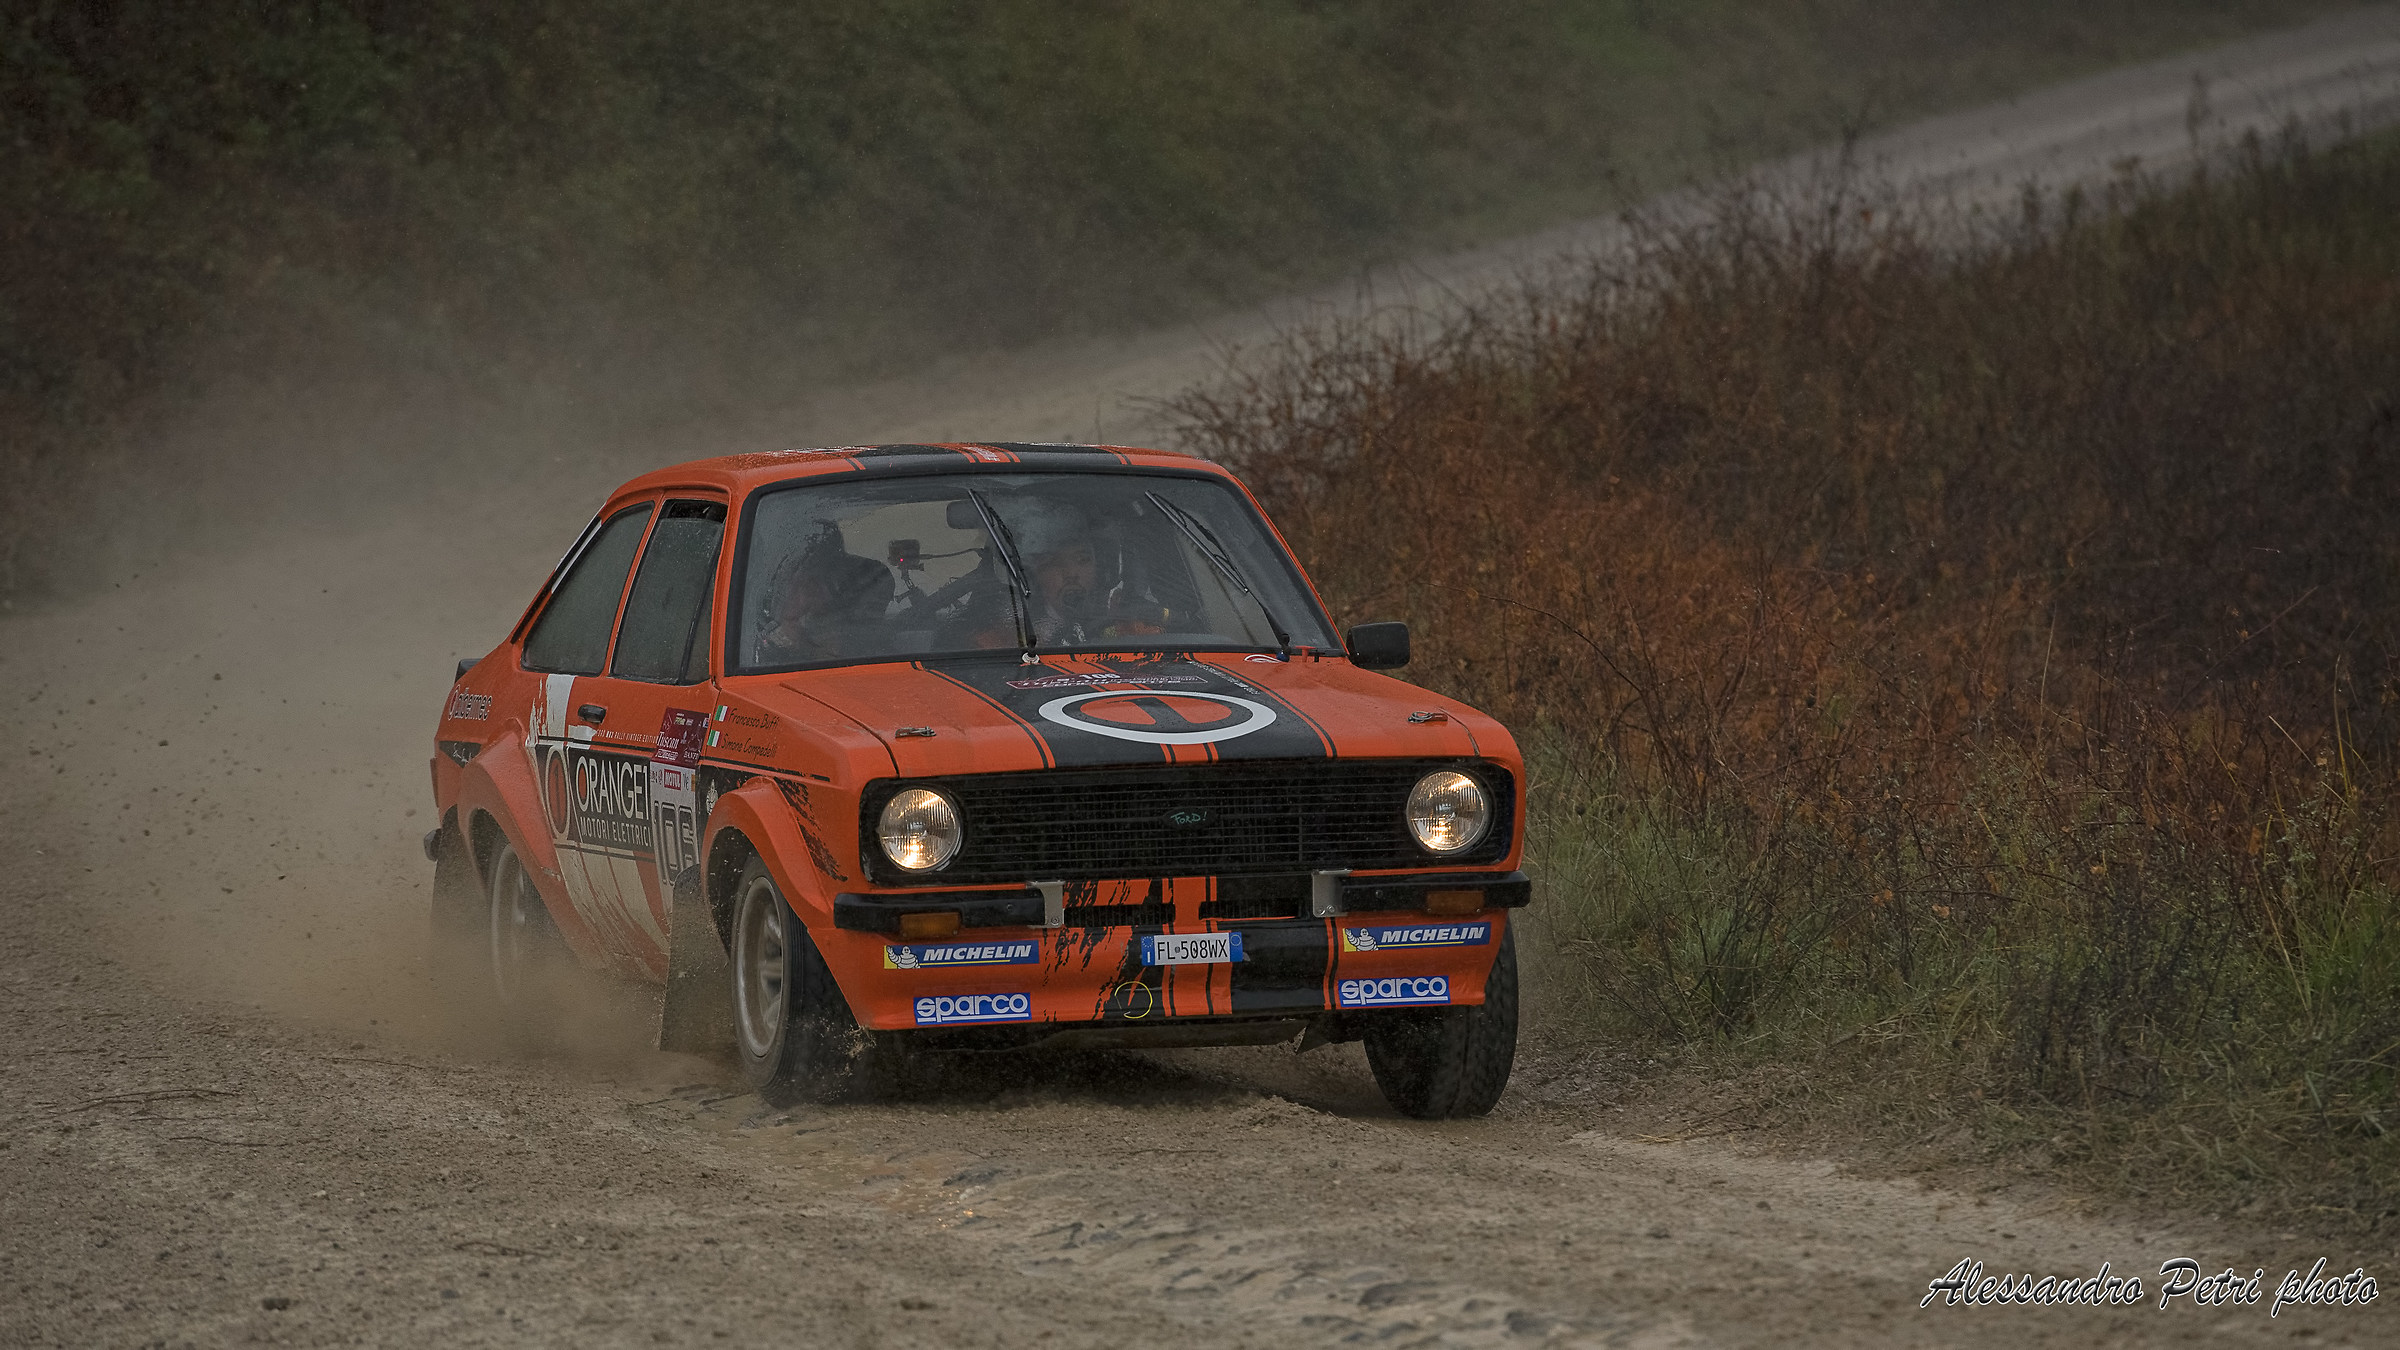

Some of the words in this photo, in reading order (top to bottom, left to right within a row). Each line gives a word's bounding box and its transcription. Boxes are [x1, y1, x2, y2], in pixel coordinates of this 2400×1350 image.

[575, 755, 650, 821] ORANGE1
[580, 816, 610, 839] MOTORI
[612, 821, 652, 848] ELETTRICI
[1380, 926, 1485, 943] MICHELIN
[923, 944, 1032, 961] MICHELIN
[1341, 976, 1447, 1005] sparco
[916, 993, 1028, 1023] sparco
